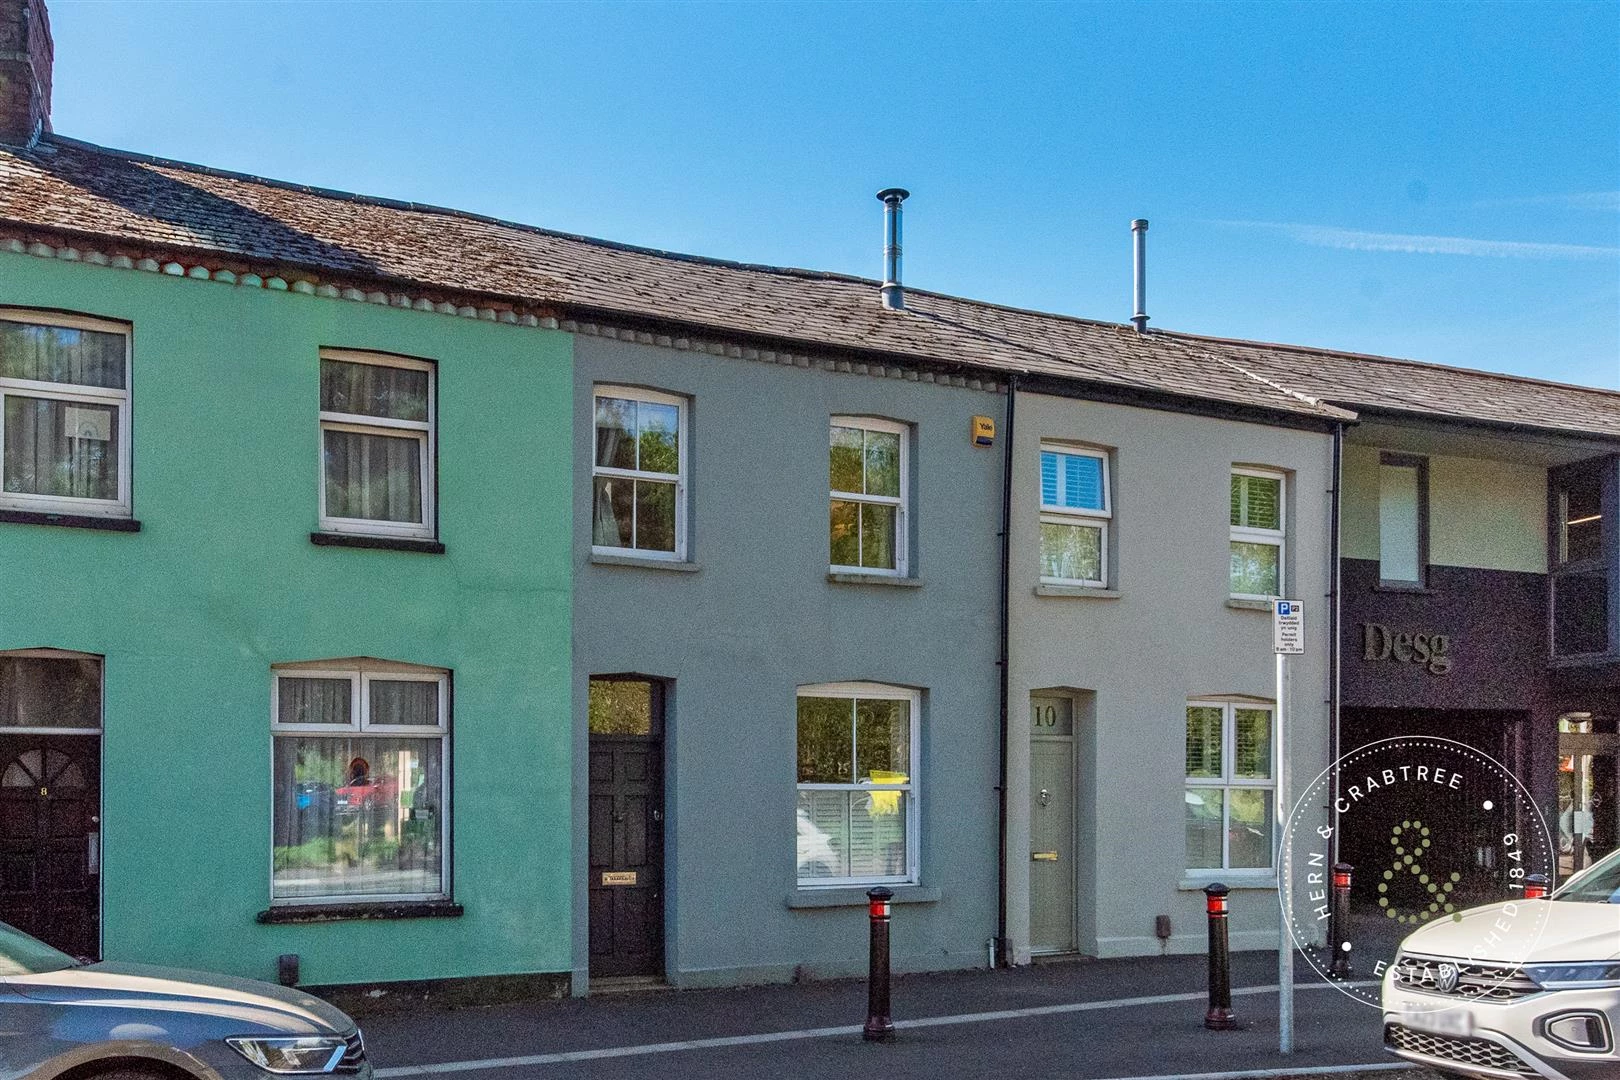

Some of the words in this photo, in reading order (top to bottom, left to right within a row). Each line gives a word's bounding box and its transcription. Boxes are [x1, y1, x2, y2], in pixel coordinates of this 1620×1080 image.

[979, 422, 993, 431] Yale
[1281, 603, 1288, 613] P
[1363, 622, 1451, 675] Desg
[1035, 705, 1056, 727] 10
[41, 787, 48, 796] 8
